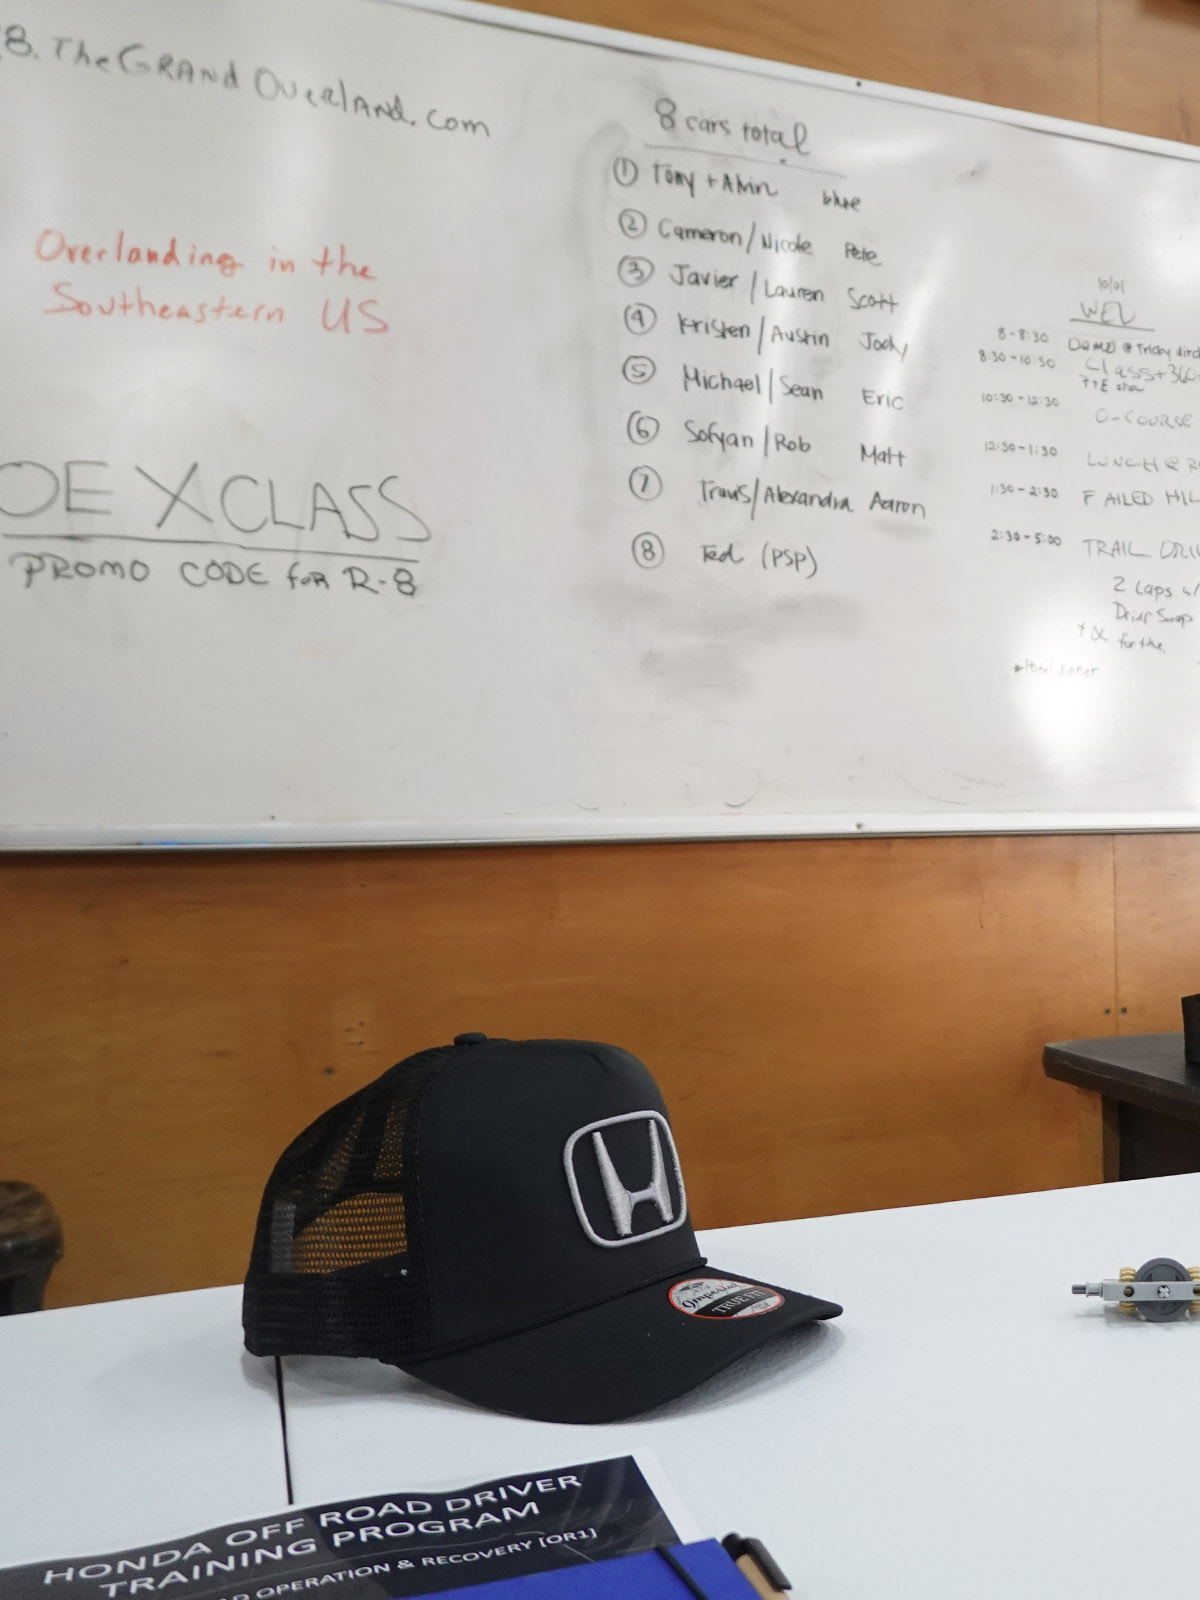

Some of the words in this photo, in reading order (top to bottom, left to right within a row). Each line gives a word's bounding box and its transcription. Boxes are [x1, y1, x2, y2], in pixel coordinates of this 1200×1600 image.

[654, 96, 677, 130] 8
[686, 115, 731, 137] cars
[743, 121, 811, 155] total
[652, 162, 695, 198] Tony
[34, 228, 246, 278] Overlanding
[269, 246, 296, 273] in
[312, 243, 379, 282] the
[41, 282, 286, 325] Southeastern
[321, 299, 391, 336] US
[847, 287, 900, 314] Scott
[861, 387, 904, 412] Eric
[859, 443, 906, 467] Matt
[868, 490, 927, 520] Aaron
[1082, 538, 1152, 559] TRAIL
[8, 553, 150, 588] PROMO
[180, 561, 269, 587] CODE
[43, 1542, 213, 1585] HONDA
[225, 1518, 305, 1548] OFF
[320, 1500, 433, 1528] ROAD
[446, 1474, 582, 1514] DRIVER
[100, 1538, 319, 1598] TRAINING
[332, 1501, 540, 1547] PROGRAM
[255, 1562, 391, 1599] OPERATION
[396, 1559, 416, 1570] &
[421, 1540, 533, 1568] RECOVERY
[538, 1527, 598, 1549] [OR1]
